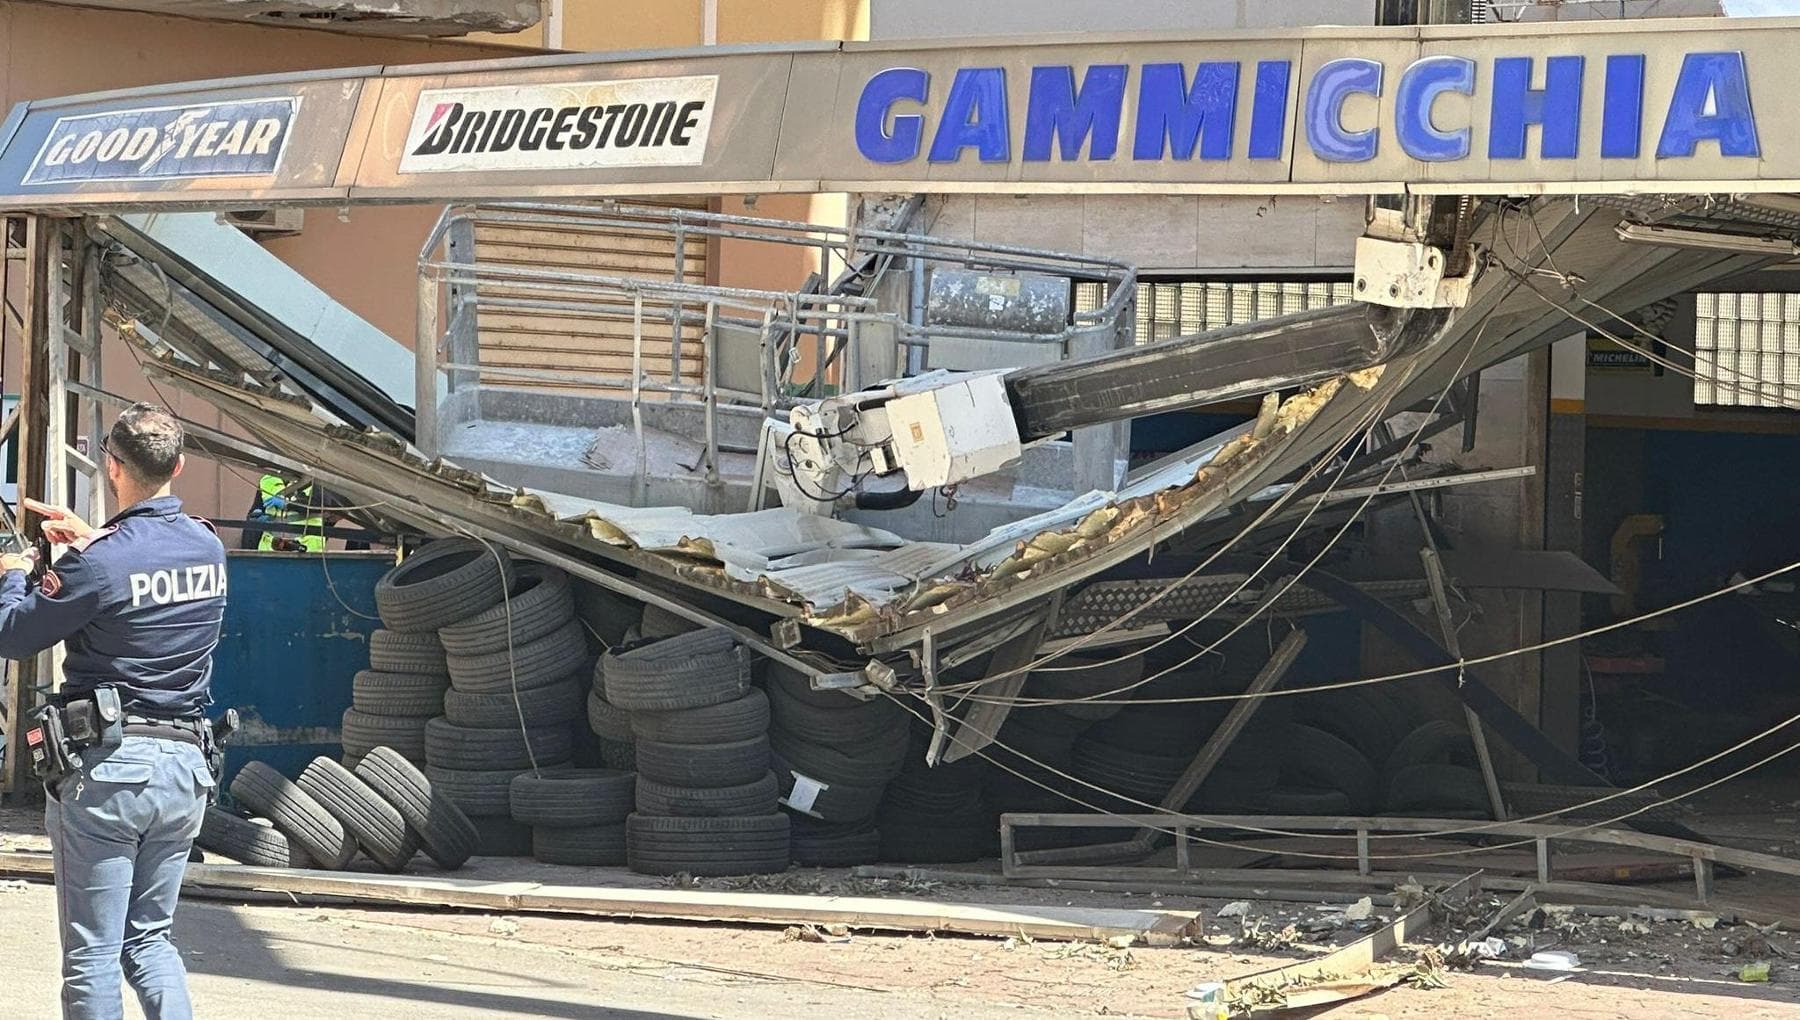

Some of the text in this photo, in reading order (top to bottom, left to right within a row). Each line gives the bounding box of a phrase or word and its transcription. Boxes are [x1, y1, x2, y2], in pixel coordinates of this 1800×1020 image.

[412, 101, 706, 156] BRIDGESTONE
[855, 51, 1760, 165] GAMMICCHIA
[129, 562, 228, 608] POLIZIA
